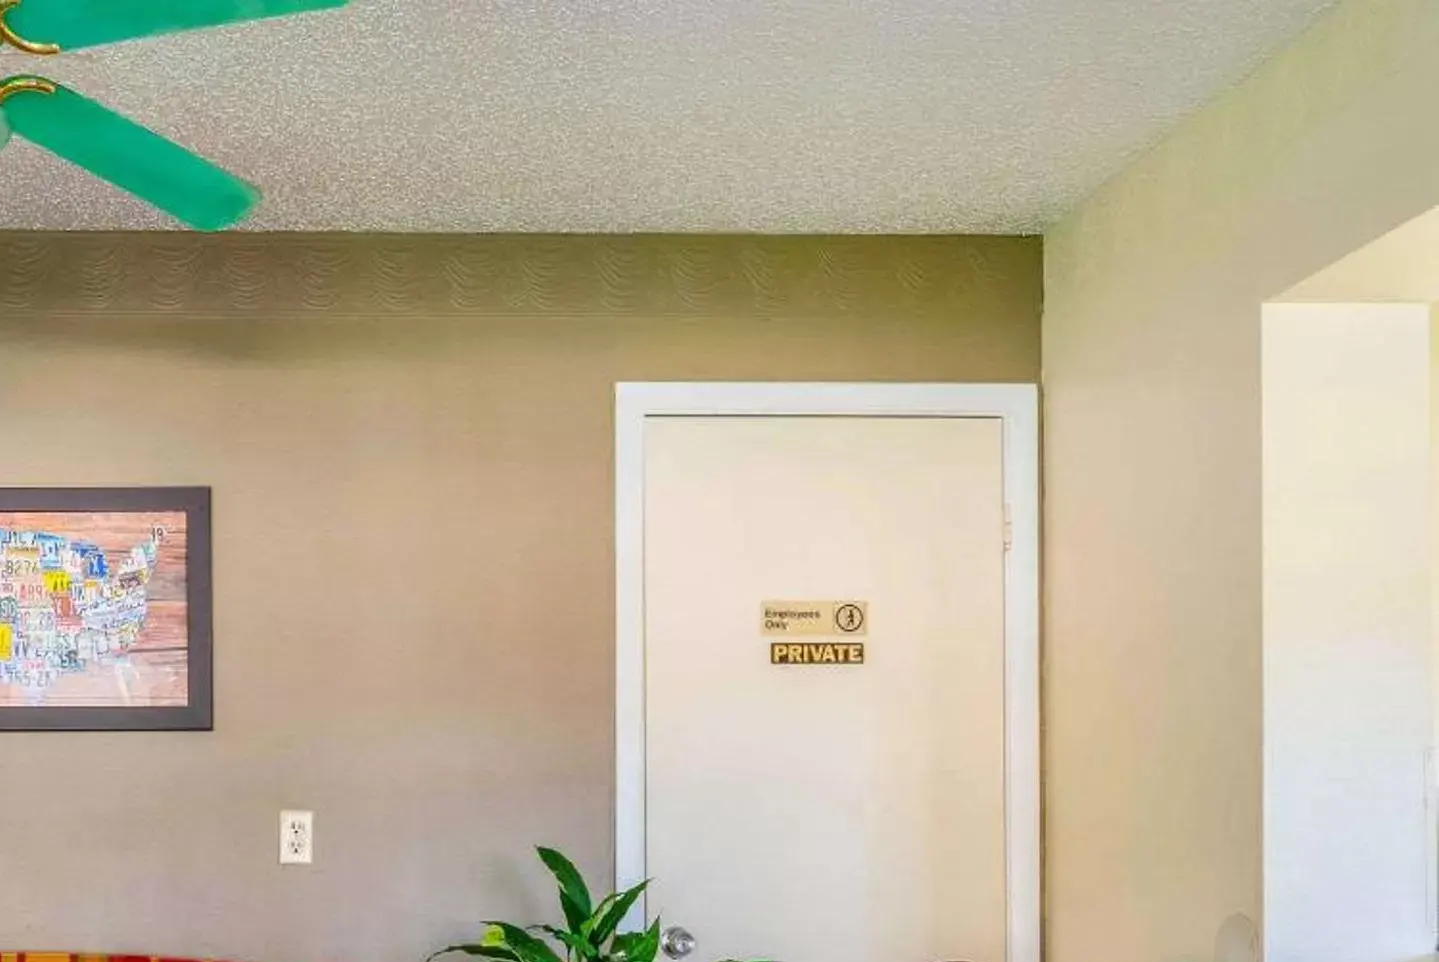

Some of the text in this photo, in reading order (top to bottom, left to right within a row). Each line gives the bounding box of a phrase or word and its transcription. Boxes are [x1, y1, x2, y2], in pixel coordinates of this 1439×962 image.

[764, 608, 821, 619] Employees
[764, 619, 788, 631] Only
[772, 643, 862, 662] PRIVATE
